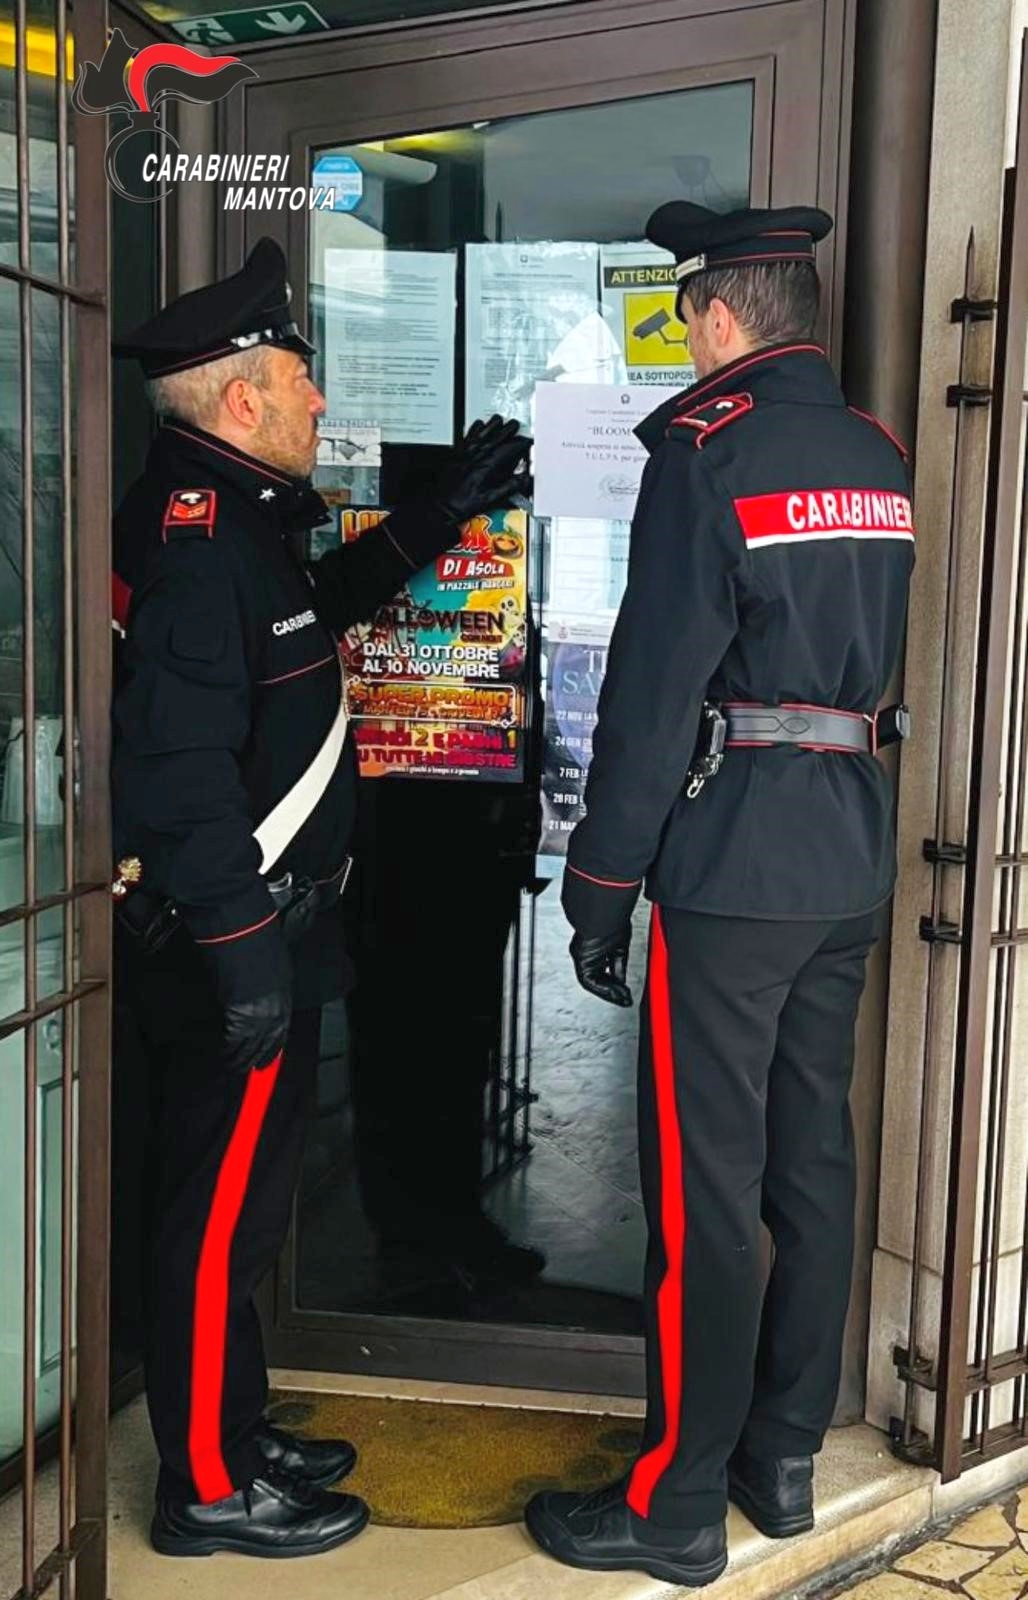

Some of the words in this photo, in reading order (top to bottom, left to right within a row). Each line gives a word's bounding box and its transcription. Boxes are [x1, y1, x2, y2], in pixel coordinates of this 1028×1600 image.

[442, 559, 462, 577] DI
[465, 560, 506, 577] ASOLA
[371, 600, 505, 634] ALLOWEEN
[362, 642, 393, 657] DAL
[400, 643, 416, 658] 31
[419, 644, 500, 662] OTTOBRE
[362, 658, 382, 673] AL
[387, 659, 403, 674] 10
[407, 661, 501, 679] NOVEMBRE
[562, 671, 603, 695] SA
[353, 685, 426, 704] SUPER
[429, 687, 510, 707] PROMO
[415, 728, 429, 746] 2
[506, 729, 518, 749] 1
[555, 736, 565, 746] 24
[559, 767, 565, 778] 7
[565, 767, 580, 779] FEB
[564, 794, 578, 805] FEB
[549, 819, 559, 831] 21
